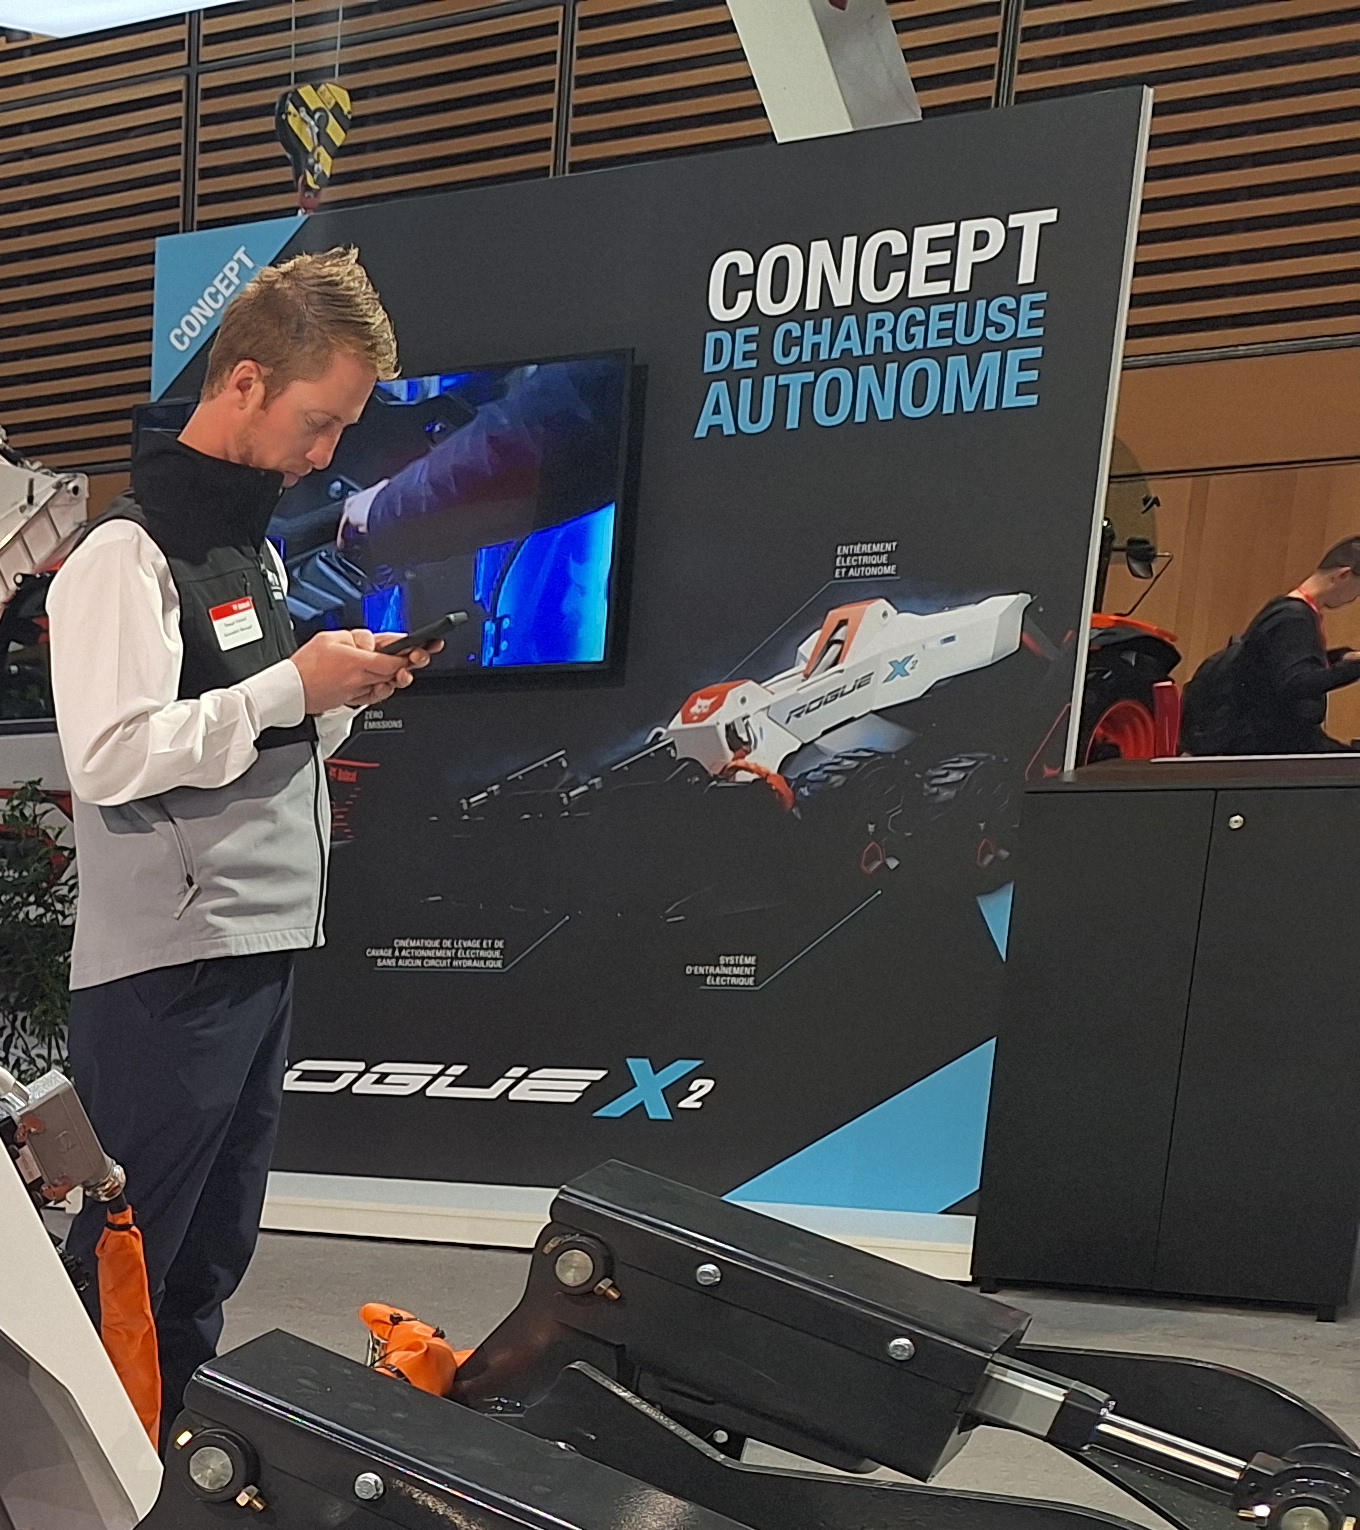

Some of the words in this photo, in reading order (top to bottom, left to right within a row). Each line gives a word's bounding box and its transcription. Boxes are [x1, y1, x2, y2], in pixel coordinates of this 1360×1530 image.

[708, 207, 1058, 321] CONCEPT
[169, 245, 255, 351] CONCEPT
[703, 326, 760, 374] DE
[773, 291, 1048, 365] CHARGEUSE
[694, 346, 1043, 439] AUTONOME
[834, 568, 847, 578] ET
[848, 564, 897, 577] AUTONOME
[837, 541, 898, 556] ENTIÈREMENT
[785, 671, 875, 725] ROGUE
[376, 958, 396, 967] SANS
[442, 939, 452, 948] DE
[483, 939, 492, 948] ET
[494, 939, 505, 948] DE
[282, 1059, 609, 1103] OGUE
